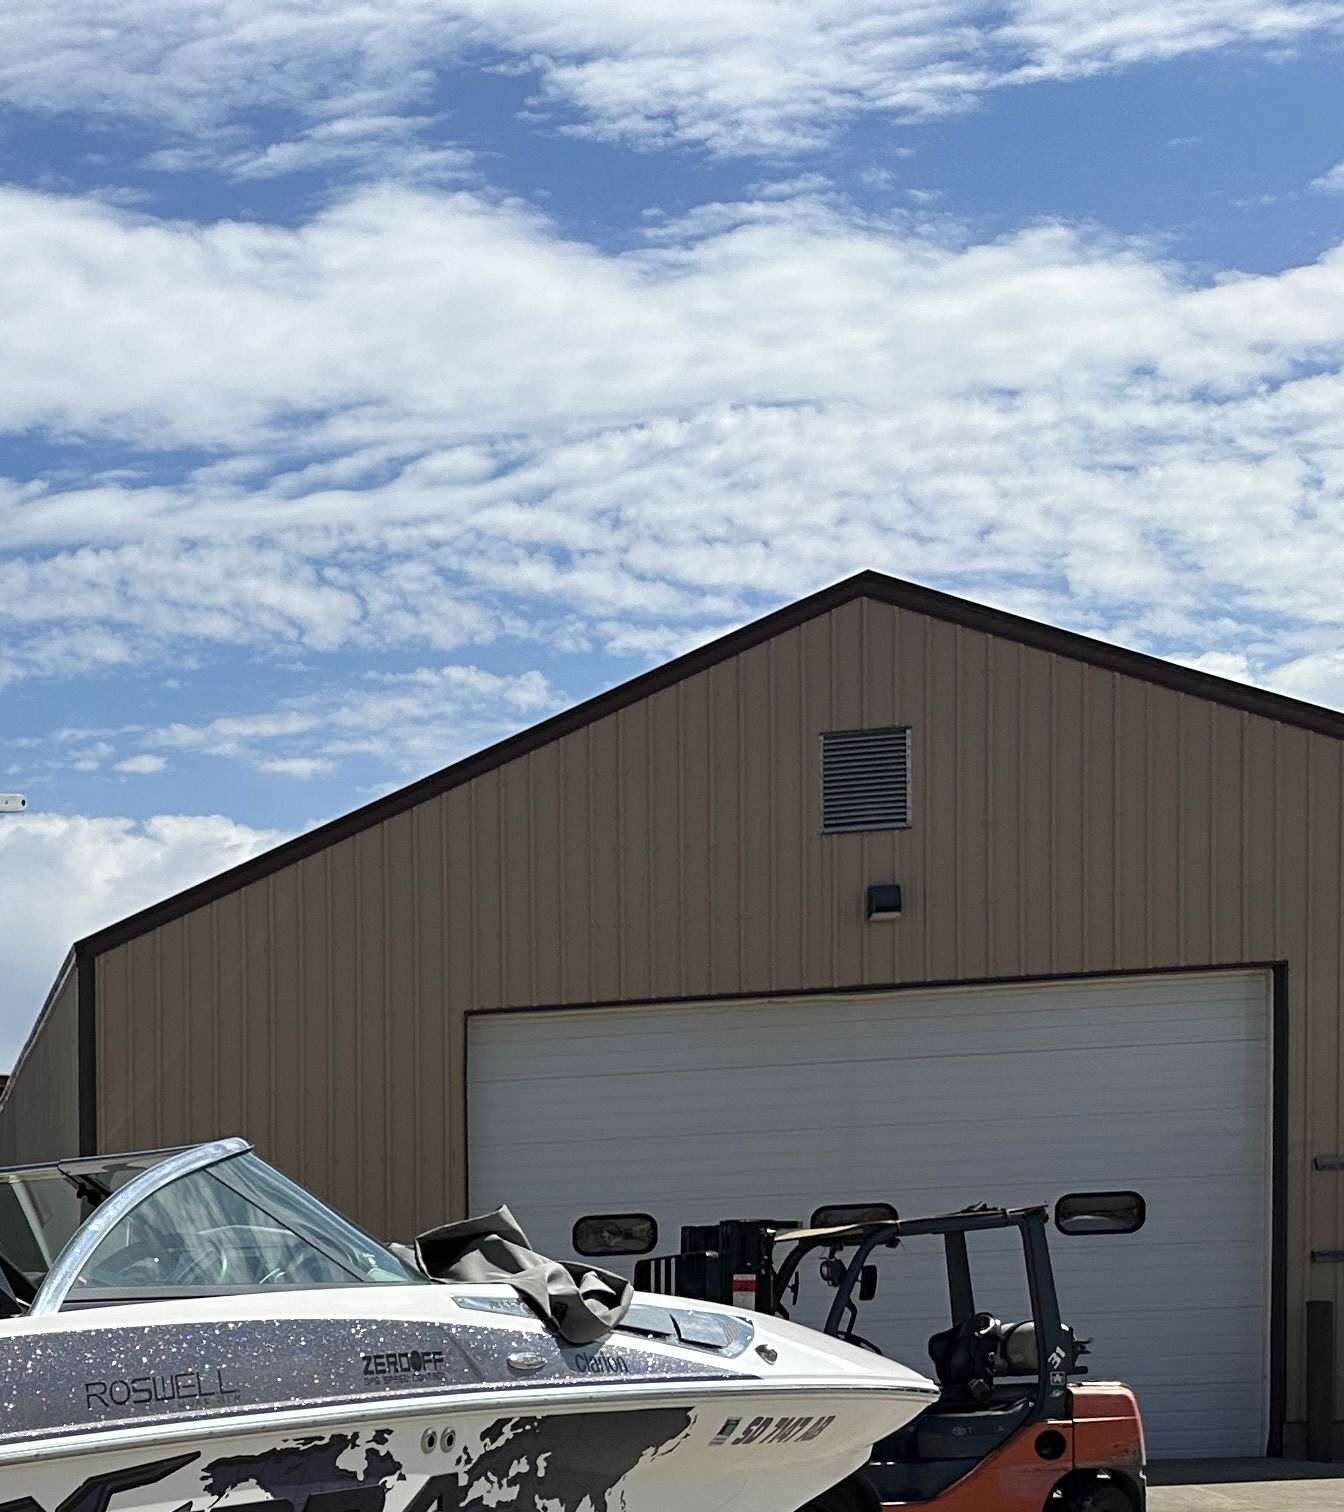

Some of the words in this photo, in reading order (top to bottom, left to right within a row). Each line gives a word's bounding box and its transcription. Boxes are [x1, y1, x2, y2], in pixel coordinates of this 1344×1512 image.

[1048, 1346, 1066, 1369] 31
[85, 1369, 237, 1409] ROSWELL
[731, 1416, 774, 1445] SD
